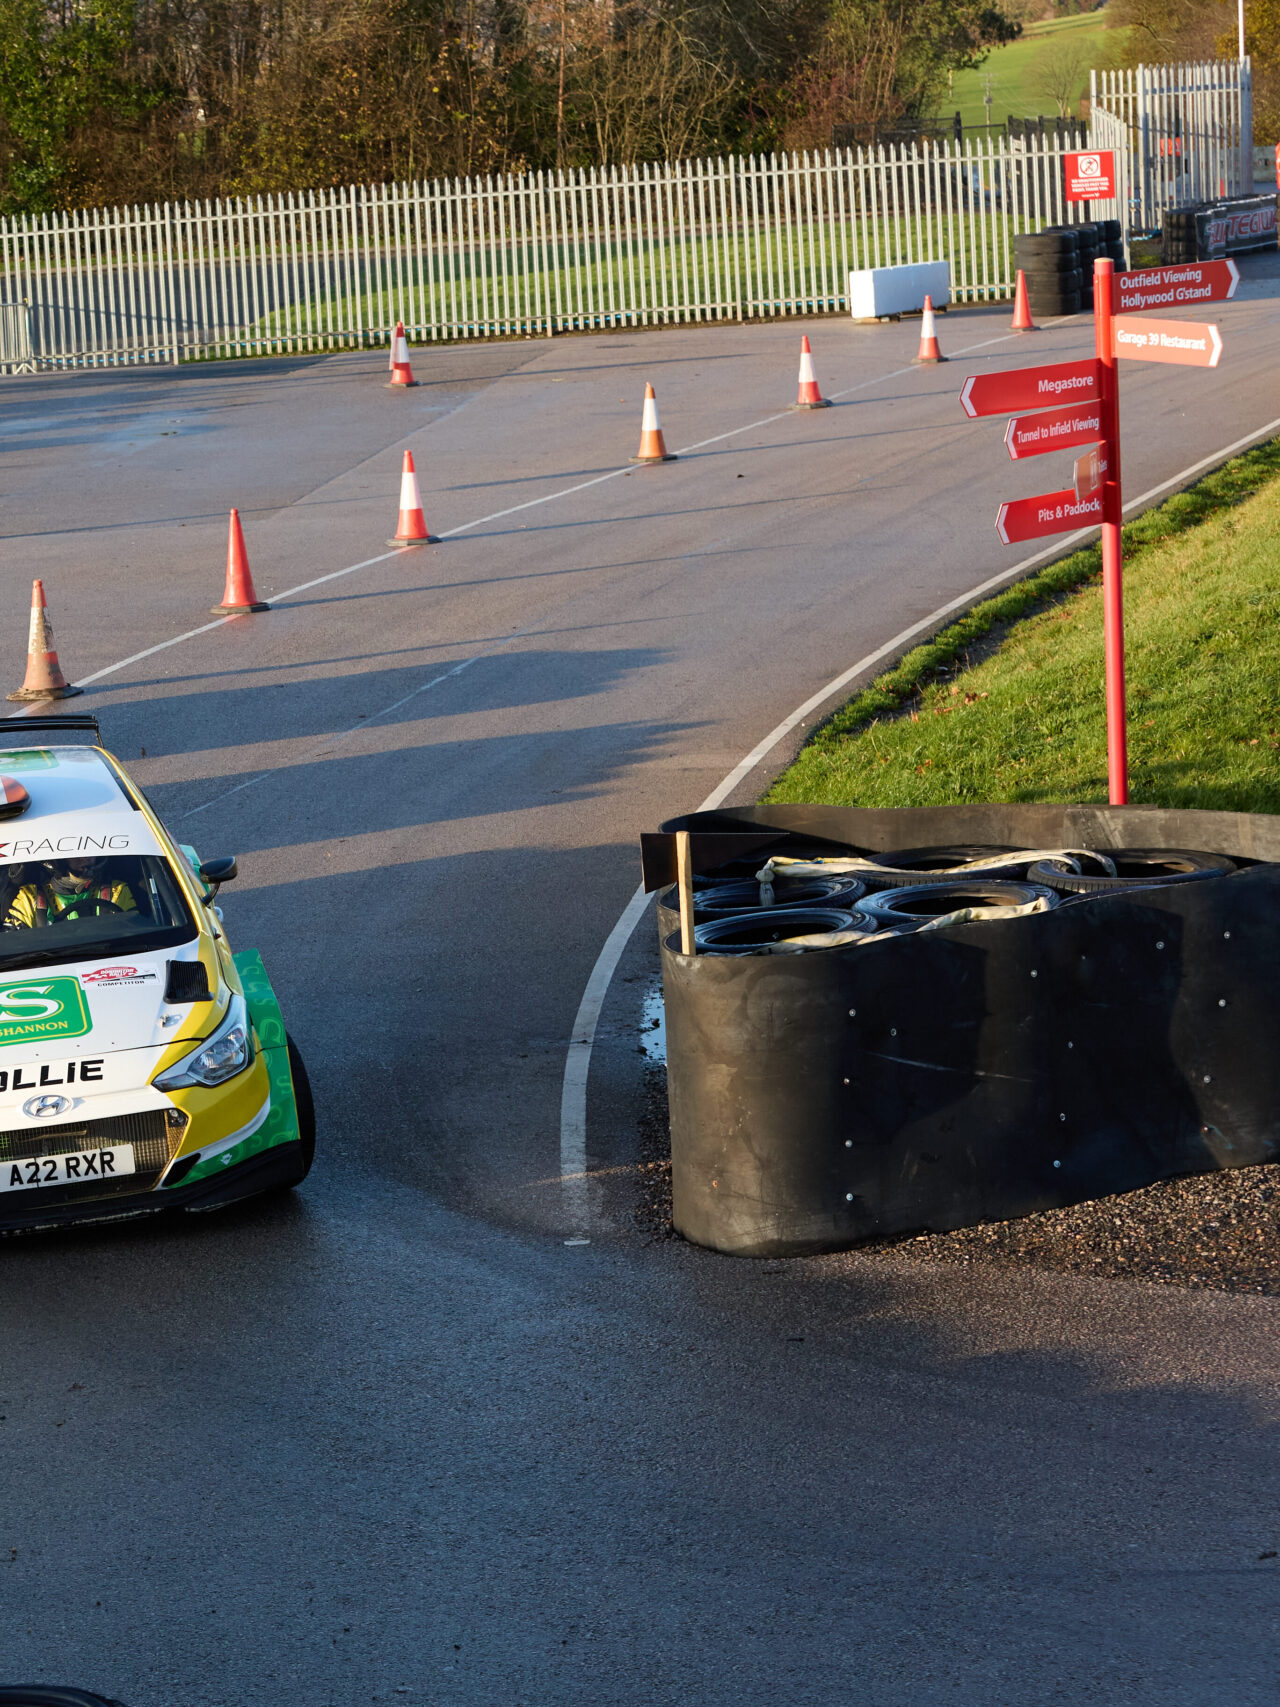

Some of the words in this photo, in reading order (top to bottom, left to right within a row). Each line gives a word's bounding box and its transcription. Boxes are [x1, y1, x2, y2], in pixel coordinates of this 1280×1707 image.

[1120, 271, 1161, 289] Outfield
[1163, 268, 1202, 284] Viewing
[1121, 289, 1174, 308] Hollywood
[1176, 283, 1212, 300] G'stand
[1117, 330, 1148, 348] Garage
[1148, 333, 1159, 346] 39
[1160, 333, 1207, 350] Restaurant
[1038, 375, 1094, 393] Megastore
[1017, 426, 1040, 443] Tunnel
[1041, 427, 1048, 439] to
[1049, 420, 1071, 436] Infield
[1072, 415, 1099, 431] Viewing
[1038, 508, 1054, 522] Pits
[1055, 506, 1062, 519] &
[1064, 497, 1100, 517] Paddock
[12, 834, 129, 857] RACING
[9, 1160, 58, 1187] A22
[65, 1151, 115, 1178] RXR
